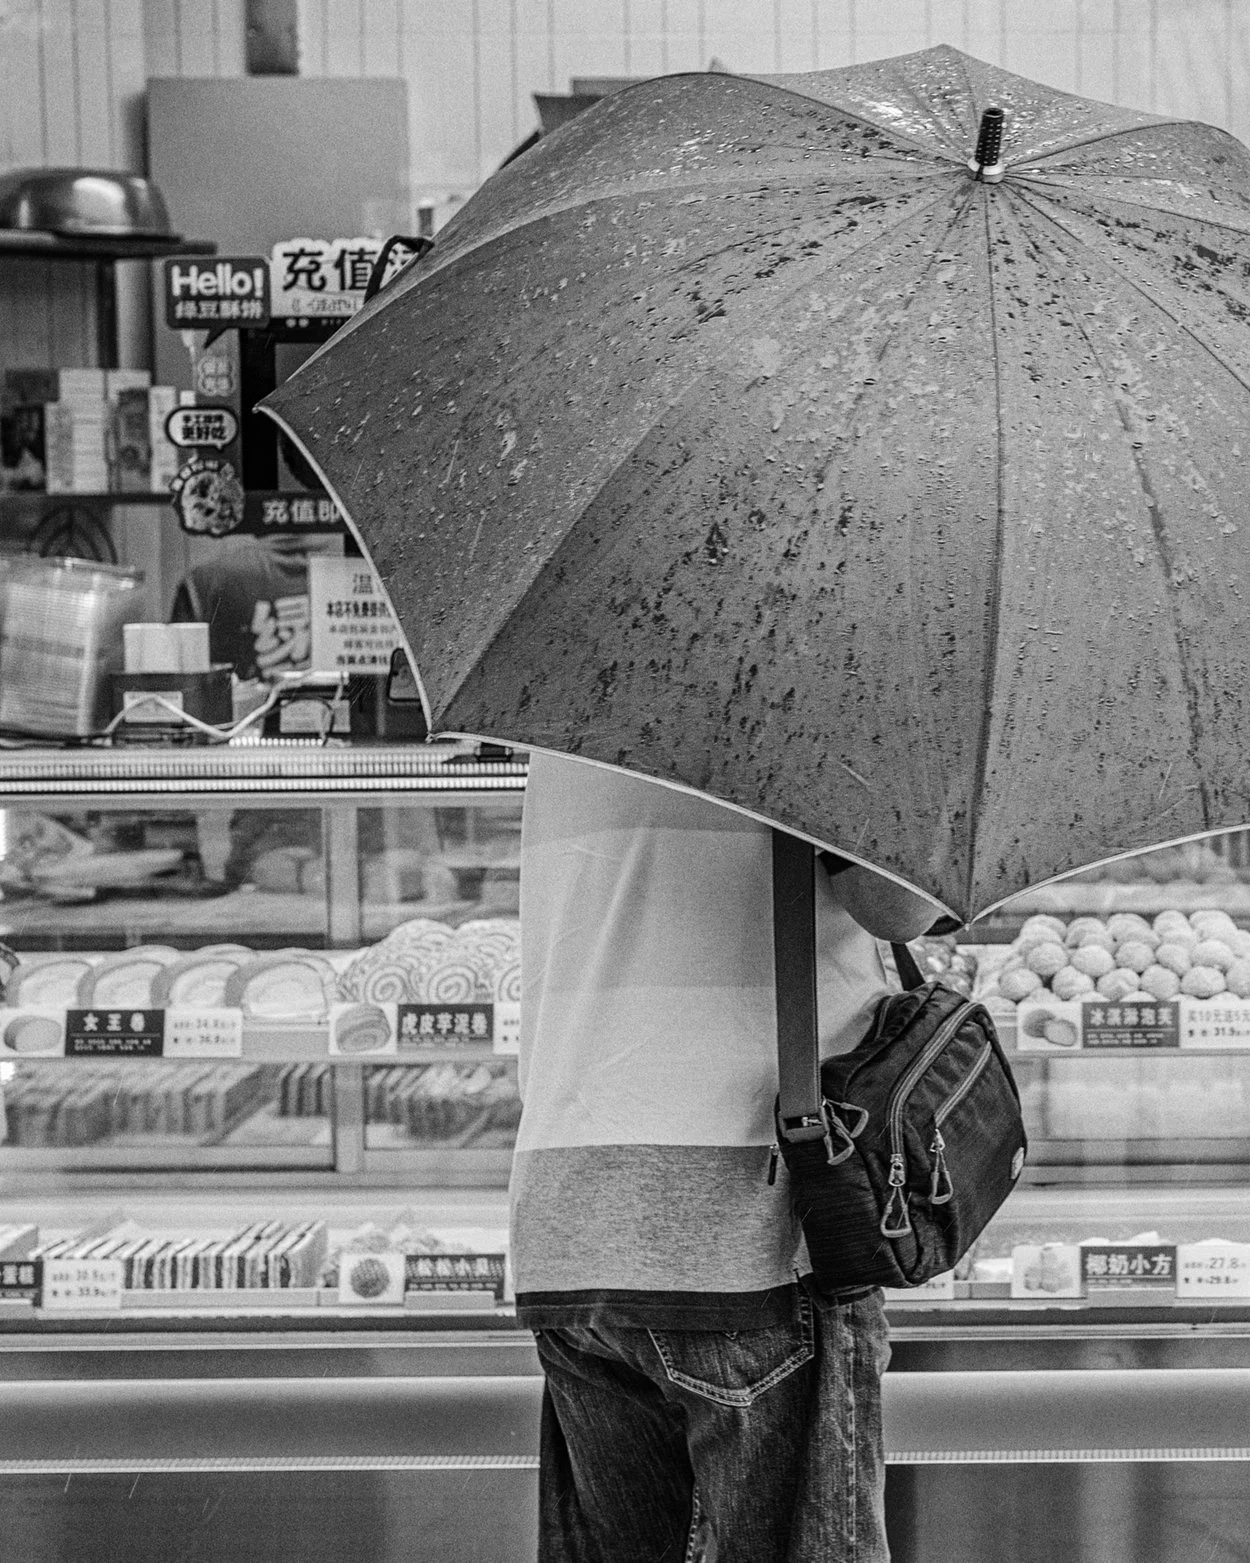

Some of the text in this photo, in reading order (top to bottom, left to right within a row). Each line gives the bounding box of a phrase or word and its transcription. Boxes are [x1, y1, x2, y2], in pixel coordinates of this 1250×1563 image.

[171, 262, 264, 298] Hello!
[182, 426, 227, 441] 更好吃
[353, 573, 381, 595] 温
[83, 1012, 146, 1032] 女王卷
[402, 1012, 488, 1035] 虎皮芋泥卷
[1089, 1007, 1173, 1026] 冰淇淋泡芙
[1085, 1253, 1173, 1275] 椰奶小方
